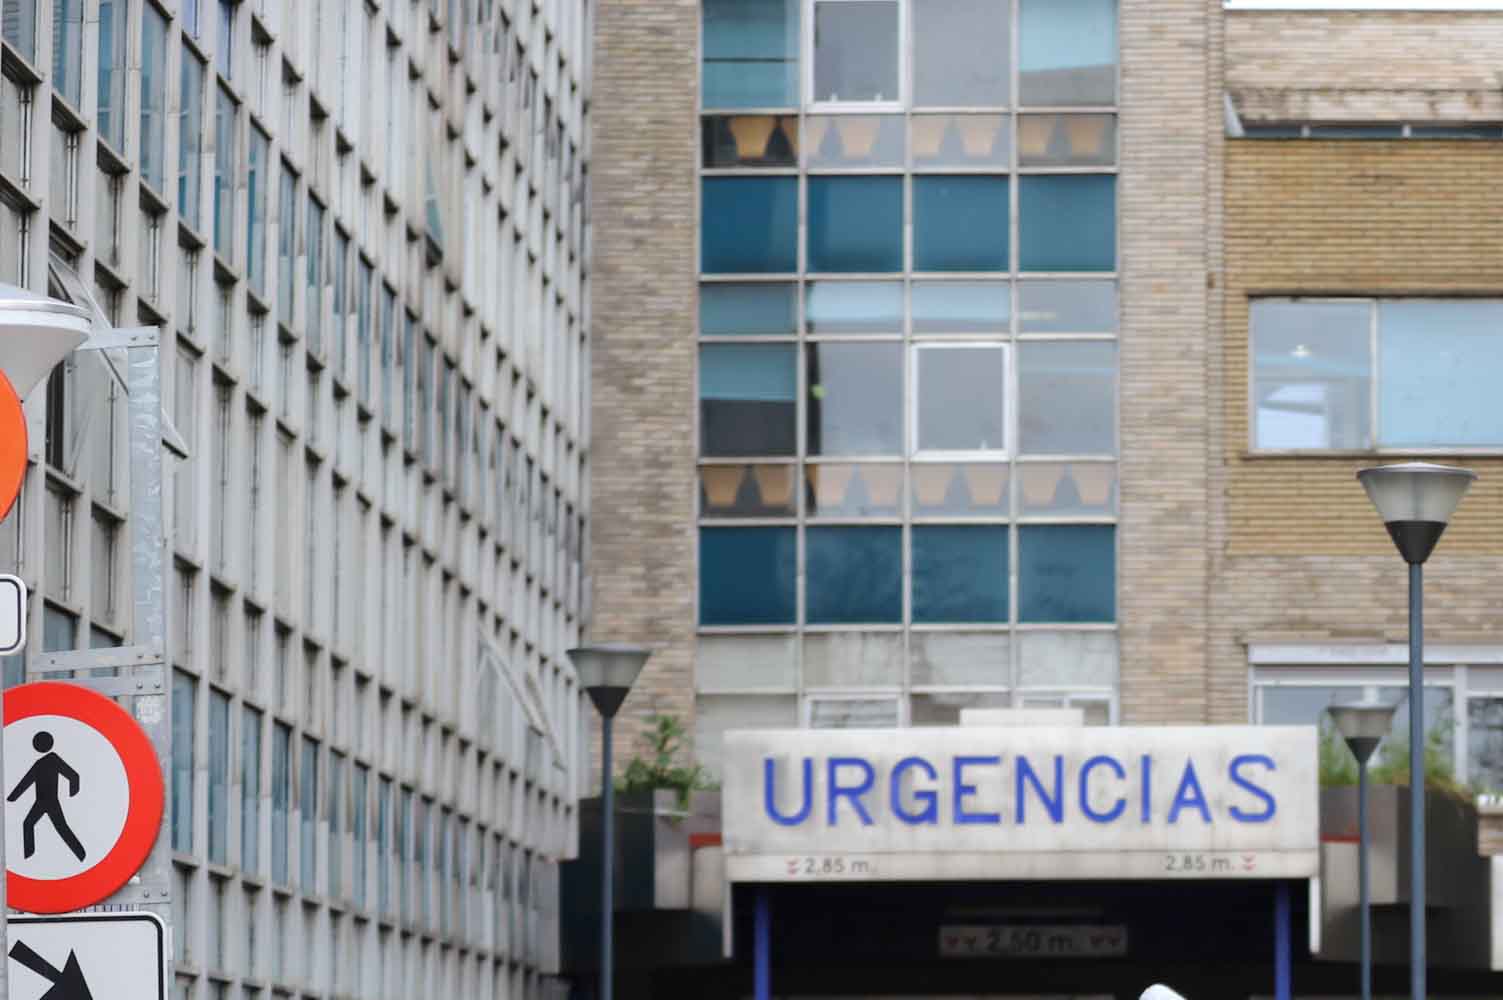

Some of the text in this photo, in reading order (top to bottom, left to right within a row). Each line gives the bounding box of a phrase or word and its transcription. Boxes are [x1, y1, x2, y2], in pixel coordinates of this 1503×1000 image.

[763, 754, 1278, 827] URGENCIAS
[803, 856, 846, 874] 2.85
[1165, 855, 1207, 872] 2.85
